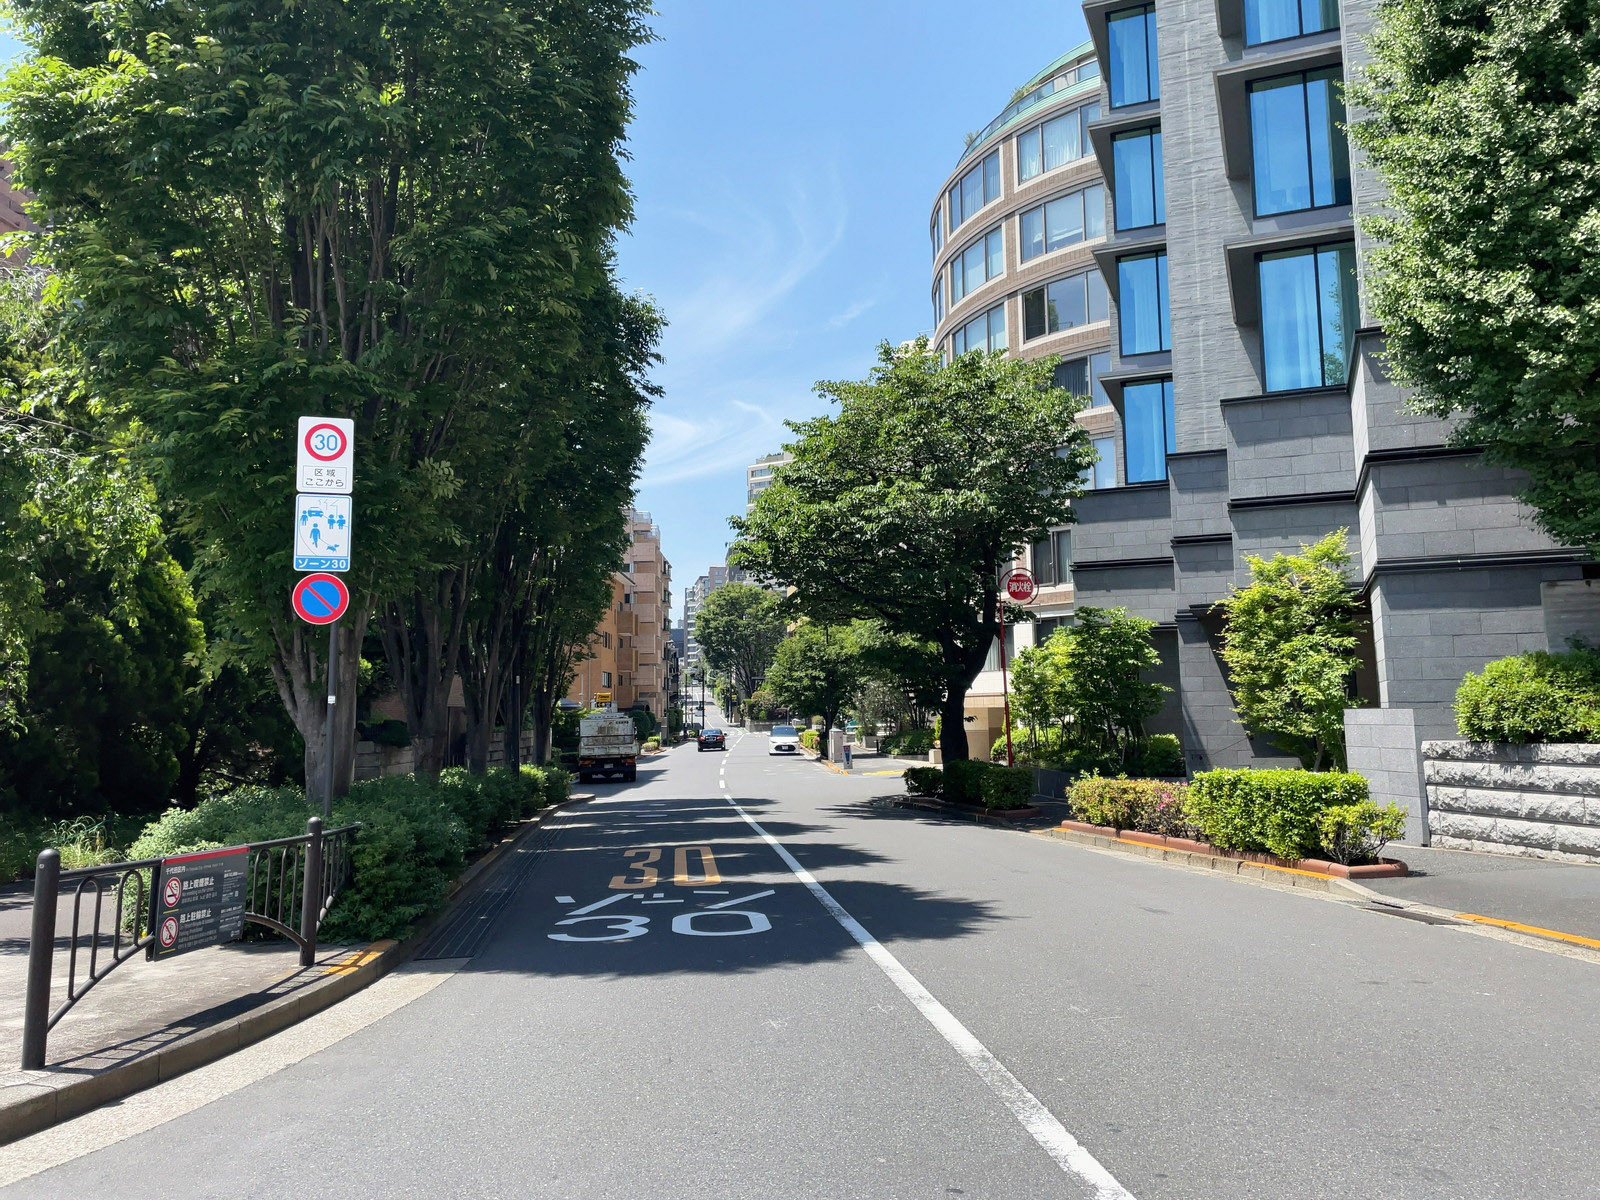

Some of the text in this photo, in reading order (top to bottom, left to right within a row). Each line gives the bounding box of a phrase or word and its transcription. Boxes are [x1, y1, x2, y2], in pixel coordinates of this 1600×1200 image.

[314, 434, 338, 451] 30
[314, 468, 336, 477] 区域
[305, 477, 344, 488] ここから
[298, 558, 346, 570] ゾーン30
[1009, 581, 1032, 592] 消火栓
[608, 846, 722, 890] 30
[547, 910, 773, 942] 30
